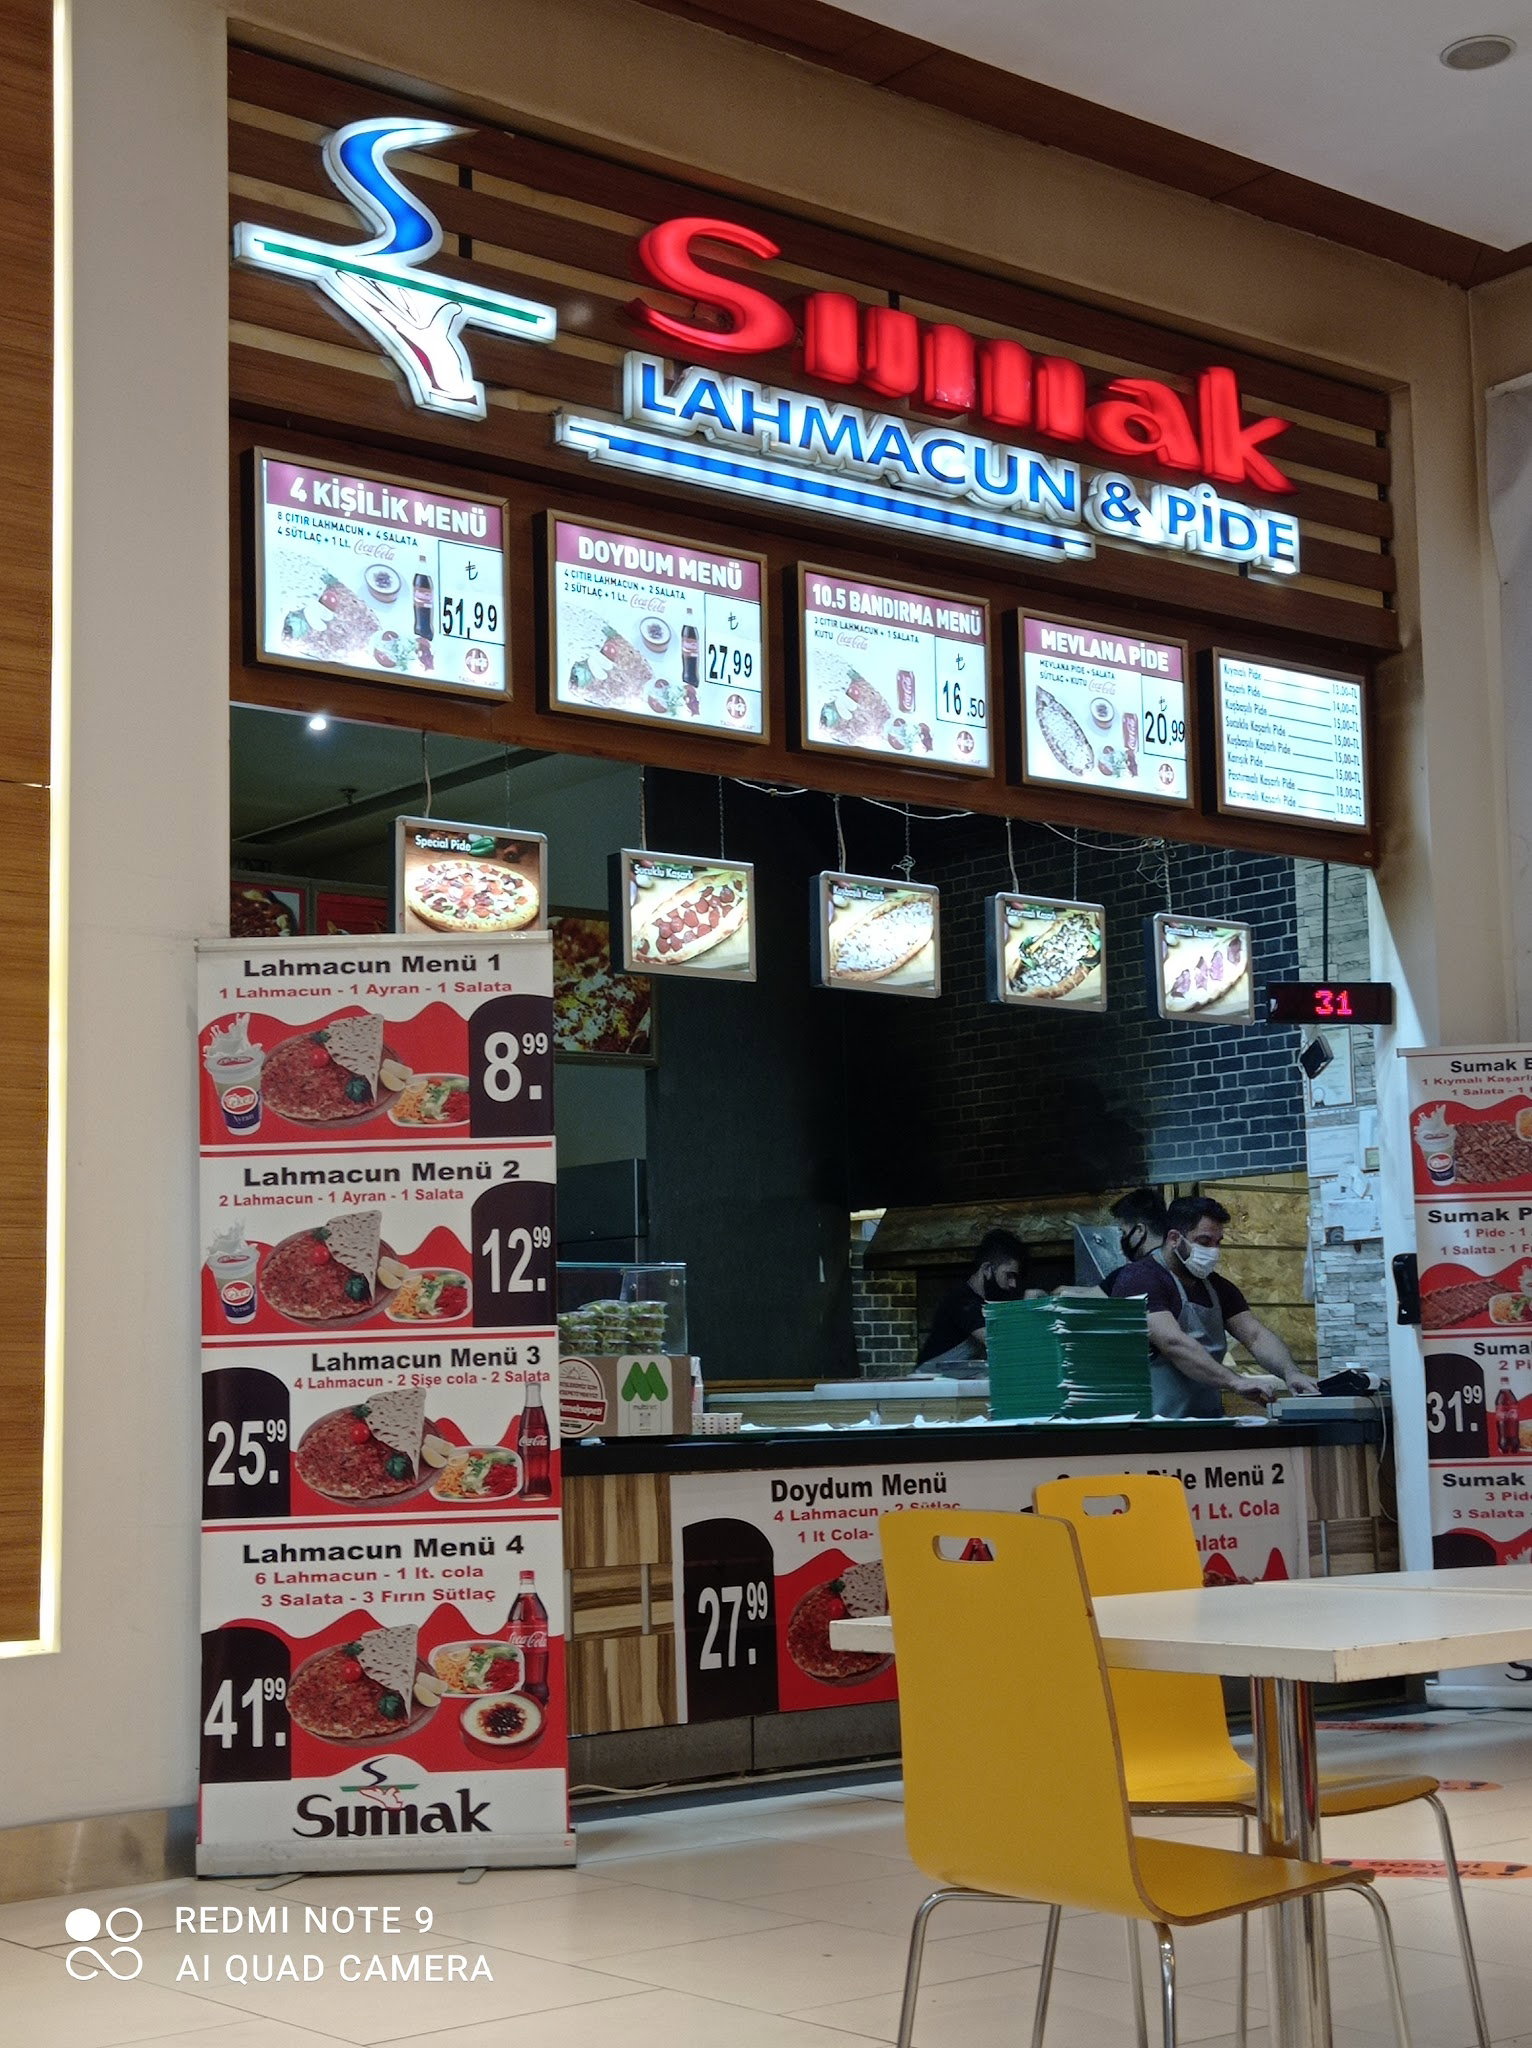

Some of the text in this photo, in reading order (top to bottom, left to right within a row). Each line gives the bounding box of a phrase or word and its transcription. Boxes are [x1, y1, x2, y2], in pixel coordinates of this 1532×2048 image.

[636, 217, 1295, 493] Sumak
[637, 359, 1296, 564] LAHMACUN & PİDE
[290, 477, 487, 538] 4 KİŞİLİK MENÜ
[276, 511, 283, 521] 8
[312, 517, 364, 536] LAHMACUN
[383, 531, 419, 547] SALATA
[277, 526, 283, 536] 4
[285, 526, 322, 544] SÜTLAÇ
[578, 536, 743, 591] DOYDUM MENÜ
[564, 568, 569, 577] 4
[594, 574, 639, 591] LAHMACUN
[649, 585, 654, 594] 2
[655, 586, 686, 600] SALATA
[564, 582, 569, 591] 2
[571, 581, 603, 600] SÜTLAÇ
[442, 596, 498, 640] 51,99
[812, 583, 982, 636] 10.5 BANDIRMA MENÜ
[814, 629, 834, 640] KUTU
[840, 620, 878, 636] LAHMACUN
[893, 631, 920, 643] SALATA
[1040, 628, 1170, 673] MEVLANA PİDE
[708, 643, 753, 684] 27,99
[1040, 659, 1069, 671] MEVLANA
[415, 834, 472, 851] Special Pide
[244, 953, 501, 977] Lahmacun Menü 1
[219, 980, 513, 999] 1 Lahmacun 1 Ayran 1 Salata
[1315, 989, 1353, 1015] 31
[1451, 1058, 1518, 1074] Sumak
[1421, 1078, 1429, 1086] 1
[1433, 1075, 1484, 1086] Kıymalı
[1451, 1086, 1505, 1096] 1 Salata
[244, 1159, 521, 1187] Lahmacun Menü 2
[218, 1188, 464, 1207] 2 Lahmacun 1 Ayran 1 Salata
[1427, 1207, 1511, 1224] Sumak
[1463, 1228, 1470, 1238] 1
[1475, 1227, 1506, 1238] Pide
[1440, 1246, 1447, 1256] 1
[1452, 1245, 1497, 1256] Salata
[312, 1345, 542, 1372] Lahmacun Menü 3
[1473, 1341, 1532, 1356] Suma
[1498, 1360, 1509, 1371] 2
[294, 1370, 551, 1390] 4 Lahmacun 2 Şişe cola 2 Salata
[1204, 1462, 1285, 1489] Menü 2
[1442, 1472, 1526, 1488] Sumak
[771, 1471, 948, 1506] Doydum Menü
[1484, 1491, 1532, 1501] 3 Pid
[773, 1506, 879, 1523] 4 Lahmacun
[1191, 1499, 1280, 1521] 1 Lt. Cola
[1452, 1508, 1525, 1519] 3 Salata
[798, 1531, 806, 1543] 1
[242, 1534, 525, 1565] Lahmacun Menü 4
[254, 1572, 266, 1586] 6
[273, 1569, 378, 1585] Lahmacun
[397, 1567, 407, 1580] 1
[442, 1565, 484, 1580] cola
[260, 1587, 496, 1607] 3 Salata 3 Fırın Sütlaç
[292, 1788, 493, 1838] Sumak
